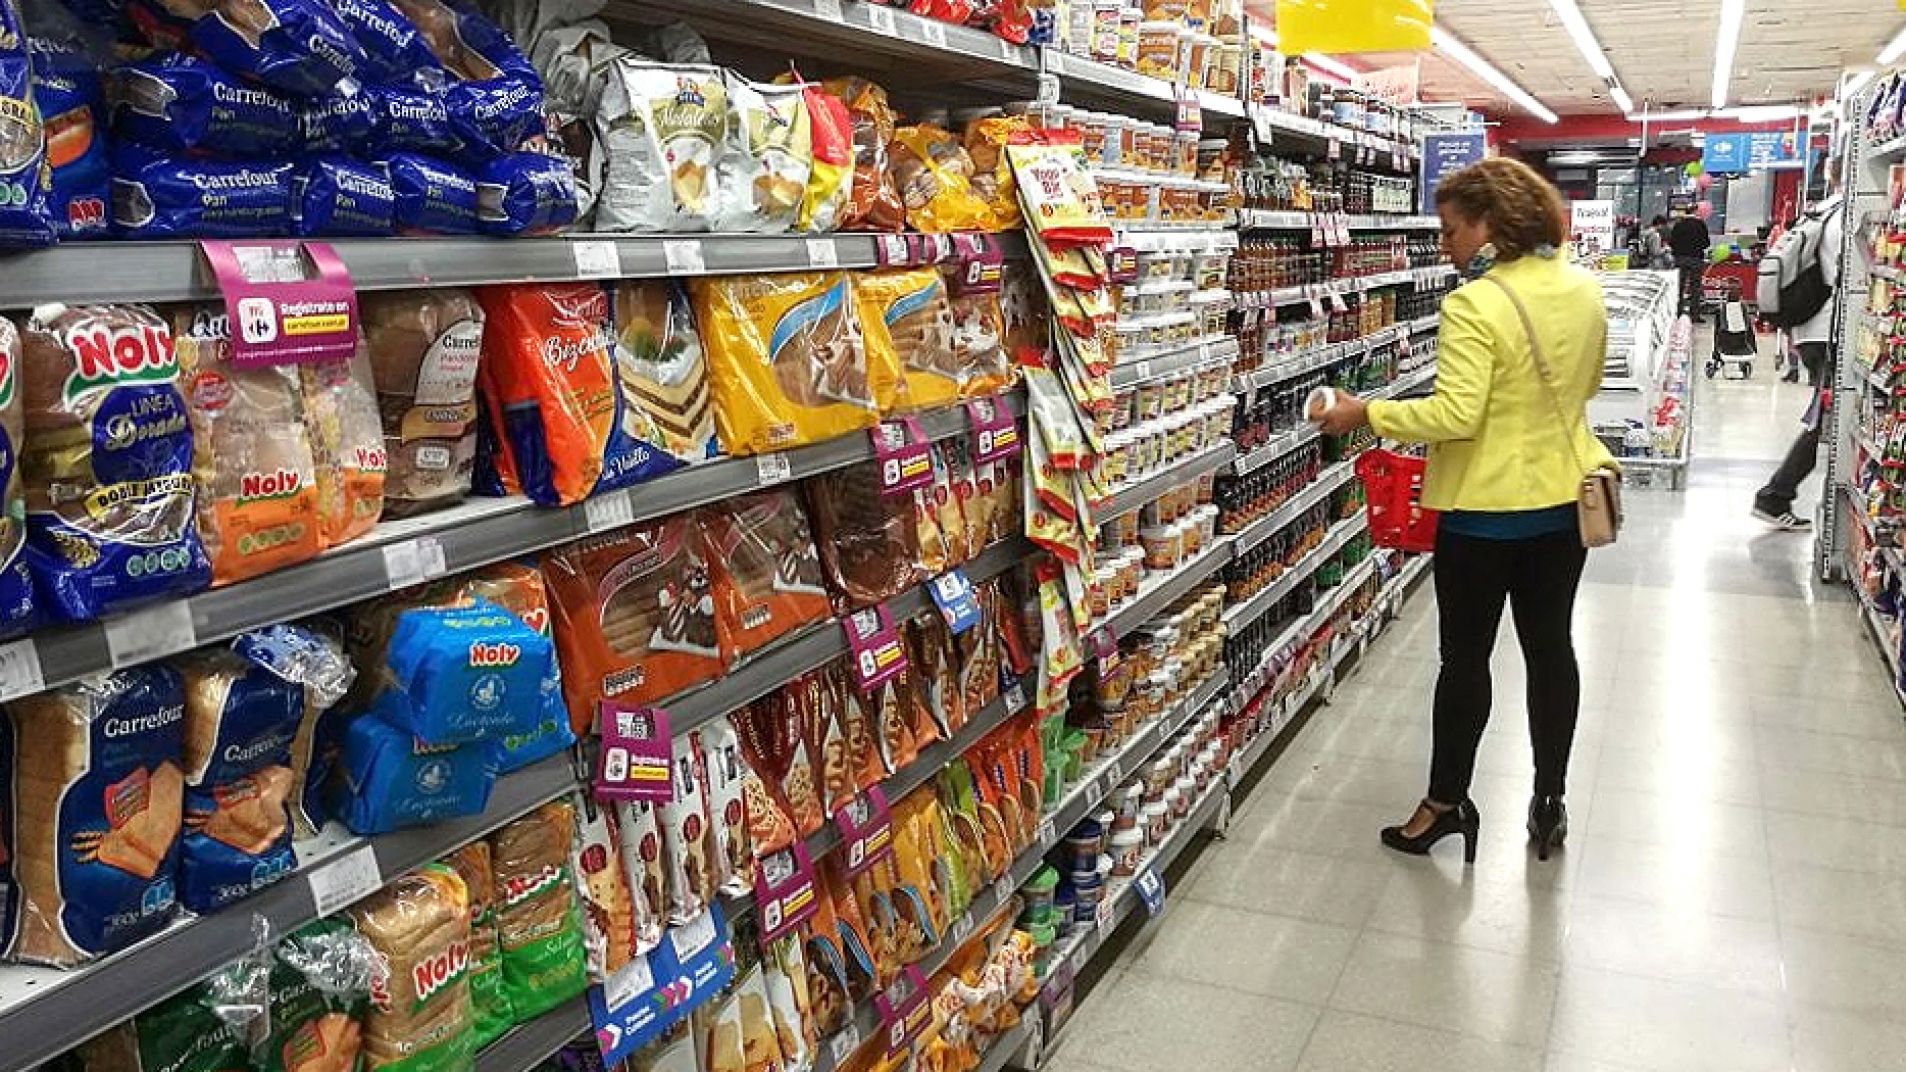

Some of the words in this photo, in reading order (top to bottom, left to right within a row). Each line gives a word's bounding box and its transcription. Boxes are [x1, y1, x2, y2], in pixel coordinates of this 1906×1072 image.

[194, 168, 279, 190] Carrefour
[201, 193, 228, 206] Pan
[242, 471, 298, 497] Noly
[472, 643, 519, 664] Noly
[105, 703, 184, 737] Carrefour
[414, 944, 469, 999] Noly
